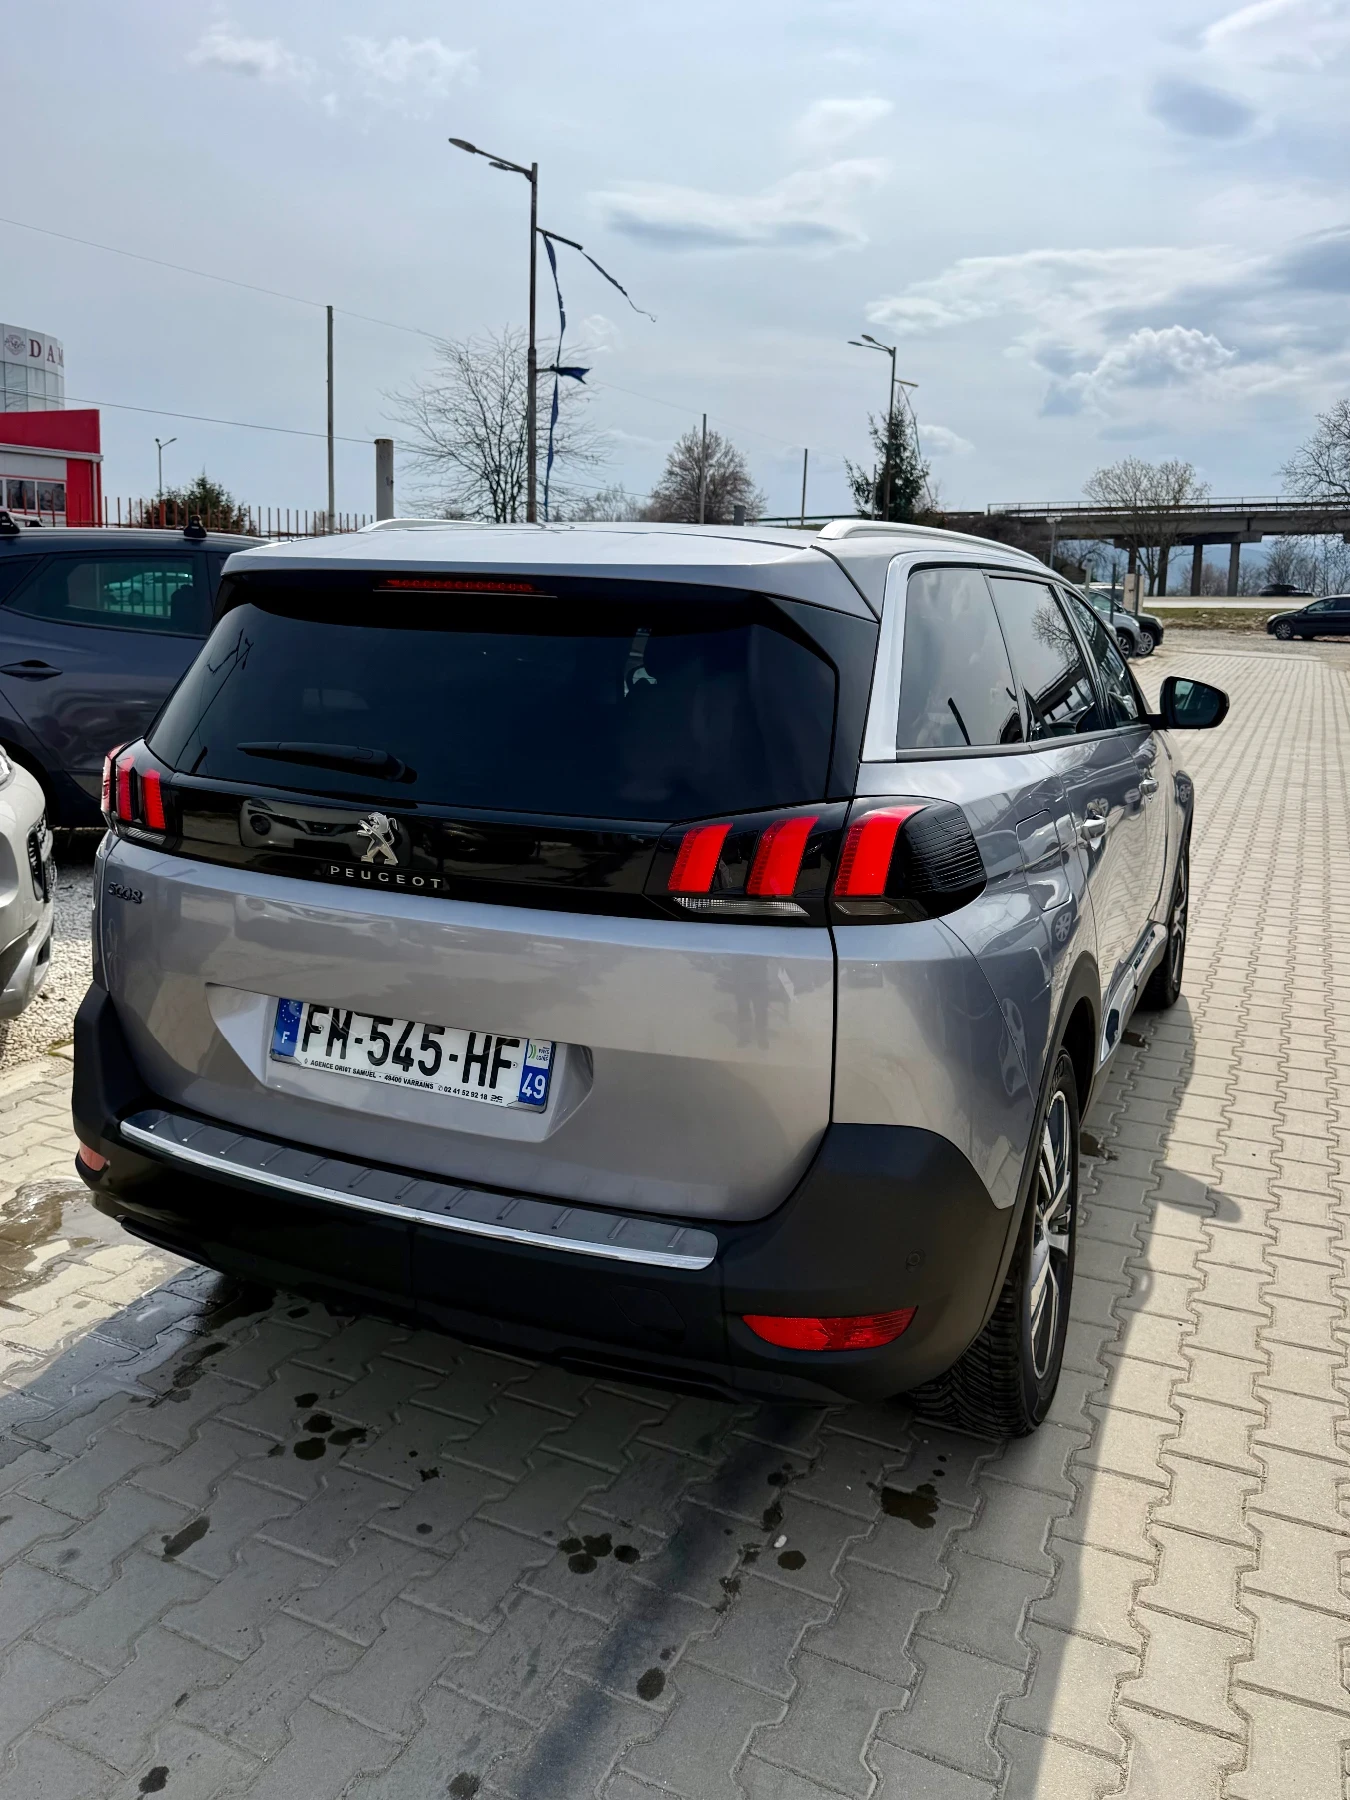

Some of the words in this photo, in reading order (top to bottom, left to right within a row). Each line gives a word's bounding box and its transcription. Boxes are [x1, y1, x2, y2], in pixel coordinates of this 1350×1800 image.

[330, 865, 441, 890] PEUGEOT
[281, 1031, 290, 1044] F
[301, 1003, 520, 1089] FM-545-HF
[310, 1060, 333, 1070] AGENCE
[352, 1068, 377, 1078] SAMUEL
[384, 1075, 402, 1084] 49400
[403, 1078, 434, 1090] VARRAINS
[452, 1087, 460, 1095] 41
[521, 1072, 546, 1099] 49
